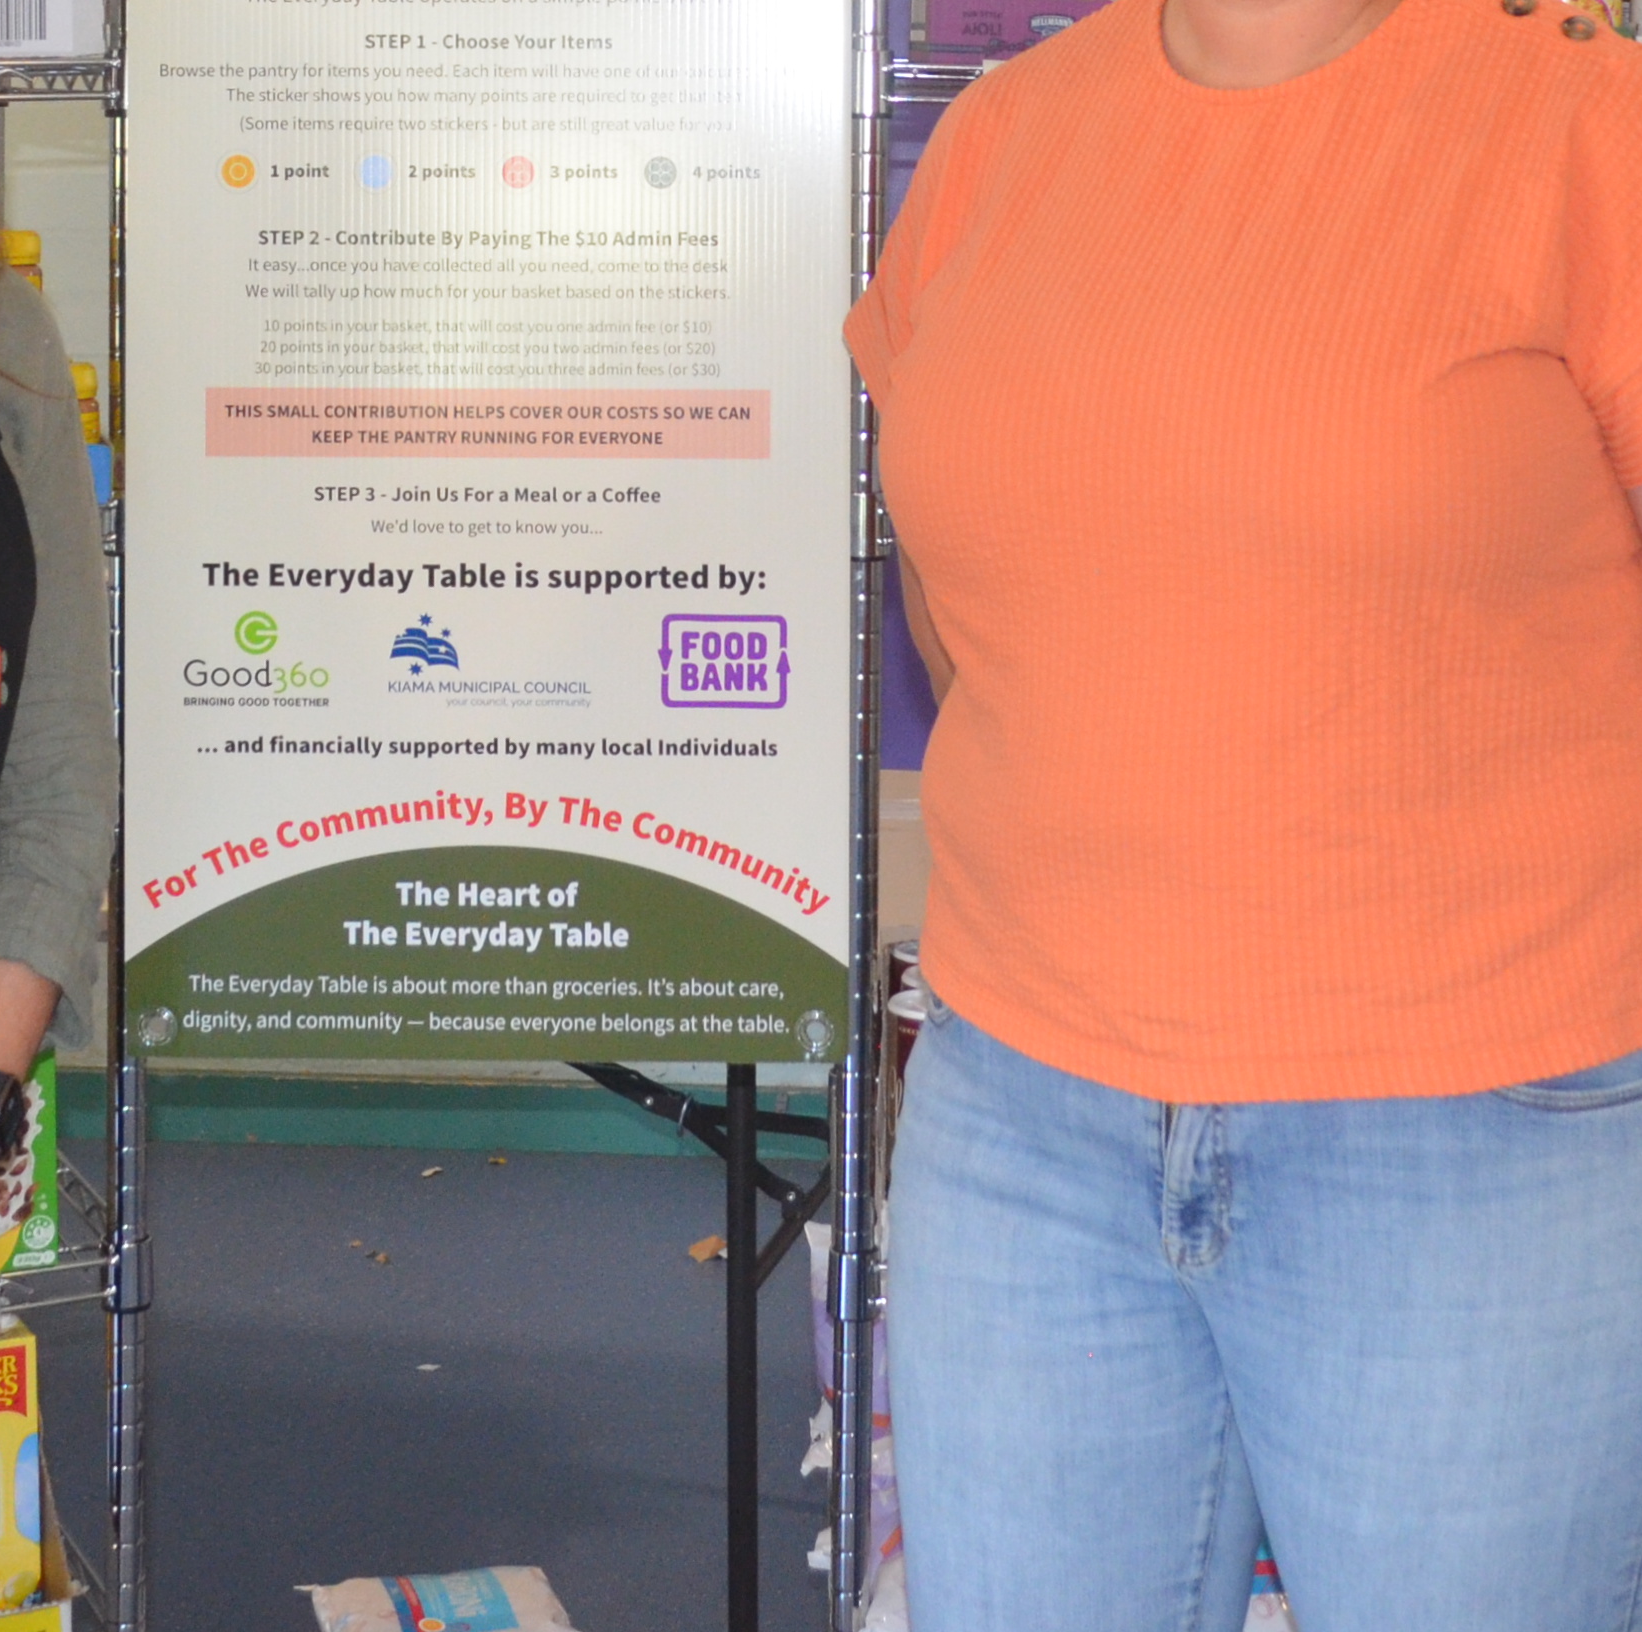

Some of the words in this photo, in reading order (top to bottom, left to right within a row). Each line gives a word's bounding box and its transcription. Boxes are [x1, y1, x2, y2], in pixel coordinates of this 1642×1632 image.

[364, 33, 412, 50] STEP
[417, 34, 426, 50] 1
[442, 33, 510, 50] Choose
[514, 34, 556, 50] Your
[561, 34, 613, 50] Items
[311, 429, 354, 444] KEEP
[357, 429, 389, 444] THE
[394, 430, 458, 444] PANTRY
[460, 430, 538, 445] RUNNING
[541, 430, 575, 445] FOR
[578, 431, 663, 446] EVERYONE
[202, 561, 259, 587] The
[269, 562, 414, 594] Everyday
[422, 562, 506, 588] Table
[515, 561, 539, 589] is
[548, 563, 709, 595] supported
[718, 564, 766, 597] by:
[681, 631, 767, 660] FOOD
[183, 659, 329, 693] Good360
[387, 680, 436, 693] KIAMA
[438, 680, 521, 694] MUNICIPAL
[523, 681, 592, 695] COUNCIL
[679, 662, 768, 693] BANK
[182, 696, 236, 707] BRINGING
[237, 697, 270, 707] GOOD
[272, 697, 330, 708] TOGETHER
[142, 865, 198, 909] For
[203, 837, 269, 878] The
[275, 790, 494, 850] Community,
[504, 792, 548, 827] By
[558, 796, 622, 833] The
[631, 812, 832, 916] Community
[395, 880, 450, 907] The
[457, 882, 541, 908] Heart
[547, 881, 579, 908] of
[342, 919, 398, 946] The
[405, 920, 543, 953] Everyday
[549, 921, 630, 948] Table
